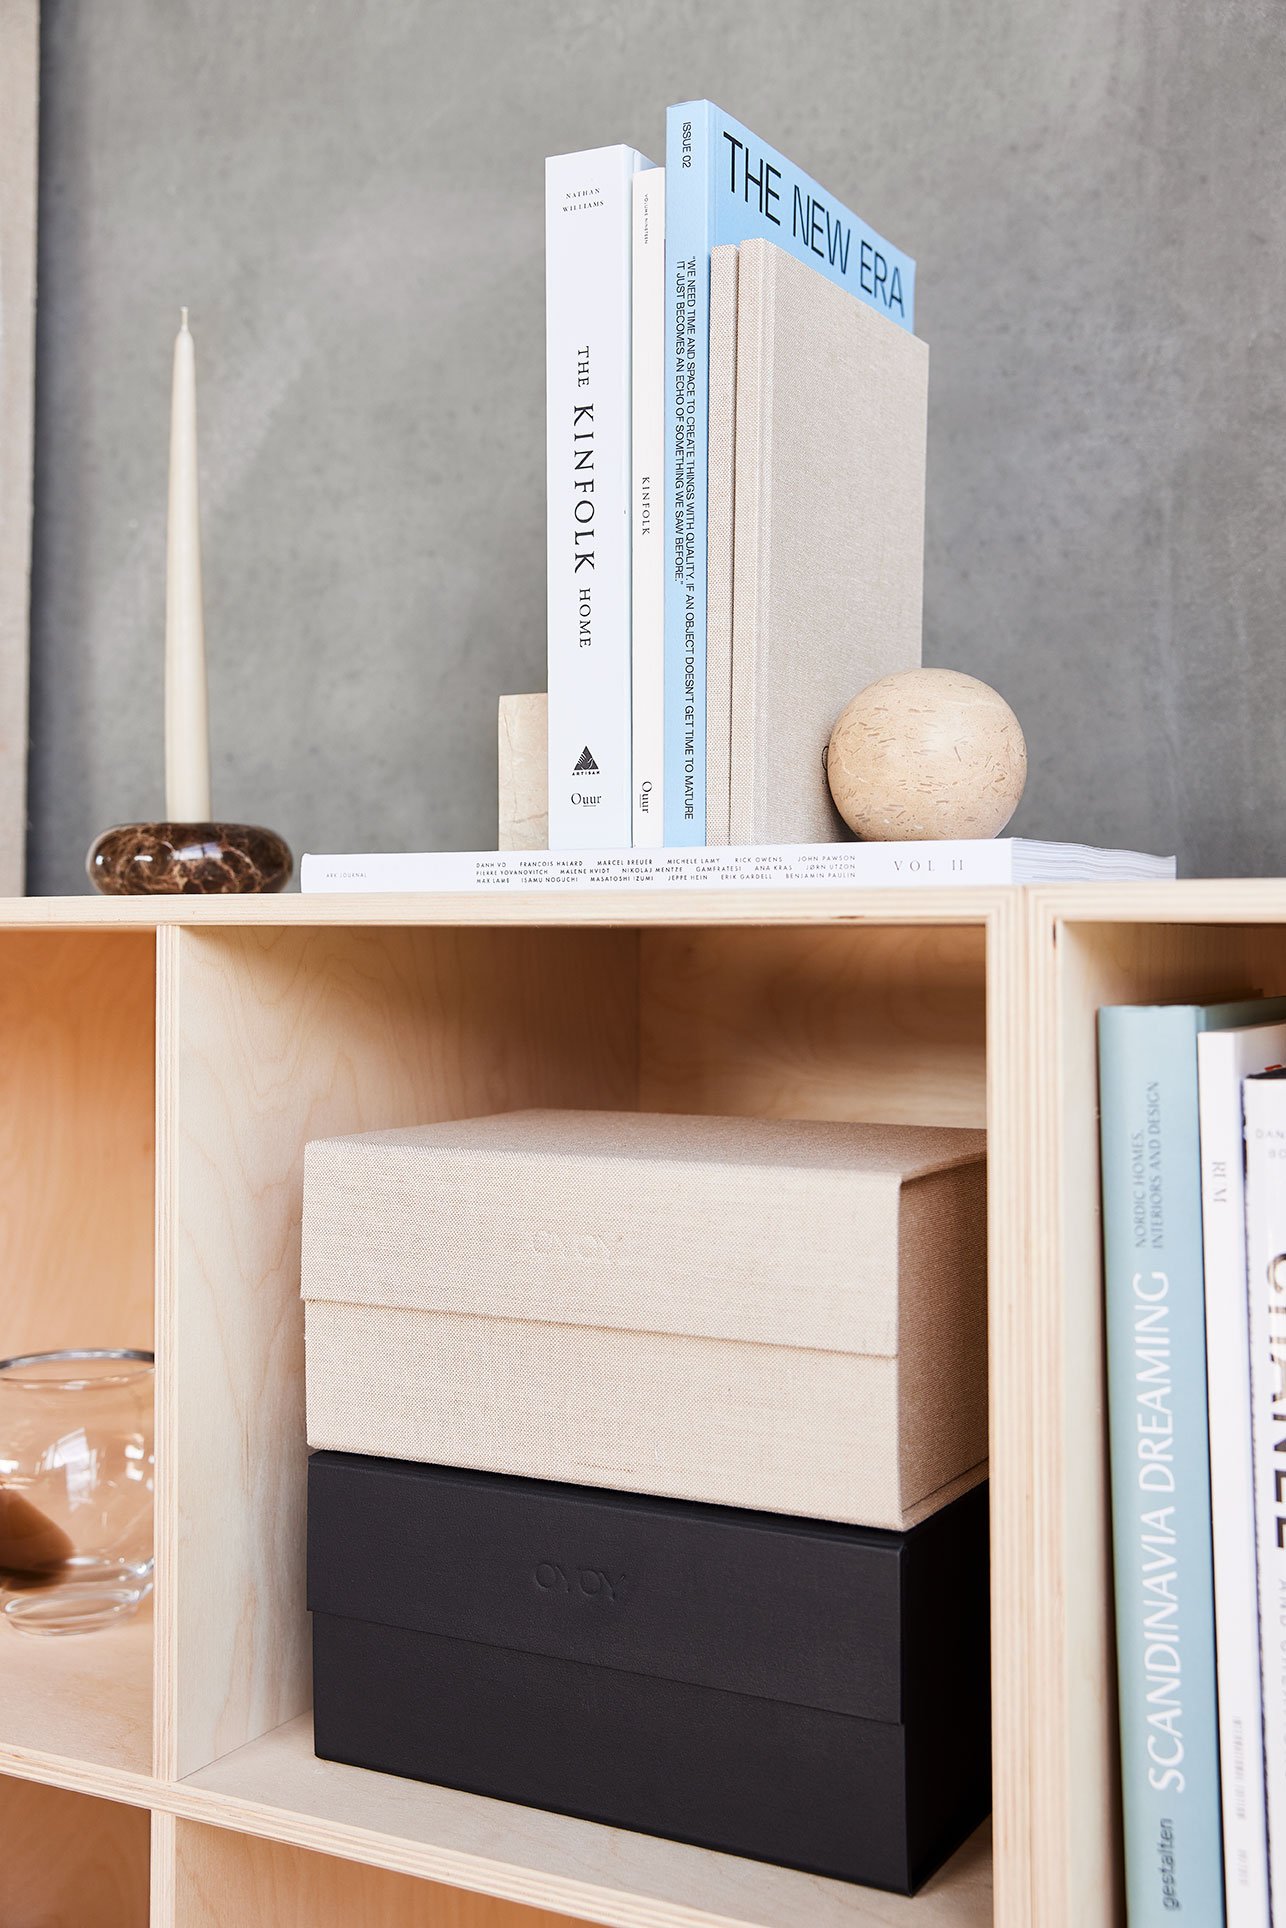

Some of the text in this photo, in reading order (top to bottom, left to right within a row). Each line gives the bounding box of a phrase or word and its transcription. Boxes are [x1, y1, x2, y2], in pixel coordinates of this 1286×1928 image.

[681, 121, 692, 169] ISSUE 02
[562, 200, 604, 213] WILLIAMS
[565, 187, 600, 200] NATHAN
[724, 131, 903, 317] THE NEW ERA
[676, 260, 686, 270] IT
[675, 272, 686, 299] JUST
[686, 279, 697, 308] NEED
[675, 301, 686, 356] BECOMES
[686, 308, 697, 335] TIME
[686, 337, 697, 360] AND
[675, 357, 686, 373] AN
[686, 361, 697, 397] SPACE
[675, 374, 686, 406] ECHO
[674, 407, 685, 423] OF
[686, 398, 697, 415] TO
[685, 416, 697, 458] CREATE
[674, 424, 685, 489] SOMETHING
[685, 459, 696, 501] THINGS
[574, 345, 595, 648] THE KINFOLK HOME
[641, 476, 651, 536] KINFOLK
[674, 490, 685, 508] WE
[673, 510, 685, 535] SAW
[685, 501, 696, 530] WITH
[685, 532, 696, 581] QUALITY.
[685, 582, 696, 592] IF
[685, 594, 696, 610] AN
[684, 612, 696, 655] OBJECT
[684, 656, 695, 704] DOESN'T
[684, 705, 695, 728] GET
[684, 729, 695, 756] TIME
[684, 757, 695, 773] TO
[570, 792, 602, 806] Ouur
[639, 780, 653, 814] Ouur
[684, 775, 695, 820] MATURE
[499, 868, 549, 876] YOVANOVITCH
[695, 865, 742, 873] GAMFRATESI
[805, 863, 826, 871] JØRN
[829, 863, 856, 871] UTZON
[626, 858, 653, 866] BREUER
[700, 857, 720, 865] LAMY
[734, 856, 752, 864] RICK
[797, 855, 819, 863] JOHN
[821, 854, 856, 862] PAWSON
[521, 876, 543, 884] ISAMU
[545, 876, 579, 884] NOGUCHI
[589, 875, 631, 883] MASATOSHI
[667, 874, 688, 882] JEPPE
[720, 873, 737, 881] ERIK
[785, 872, 825, 880] BENJAMIN
[1146, 1081, 1165, 1249] INTERIORS AND DESIGN
[1132, 1190, 1147, 1249] NORDIC
[1132, 1272, 1185, 1793] SCANDINAVIA DREAMING
[533, 1561, 627, 1603] OYOY
[1158, 1817, 1182, 1911] gestalten
